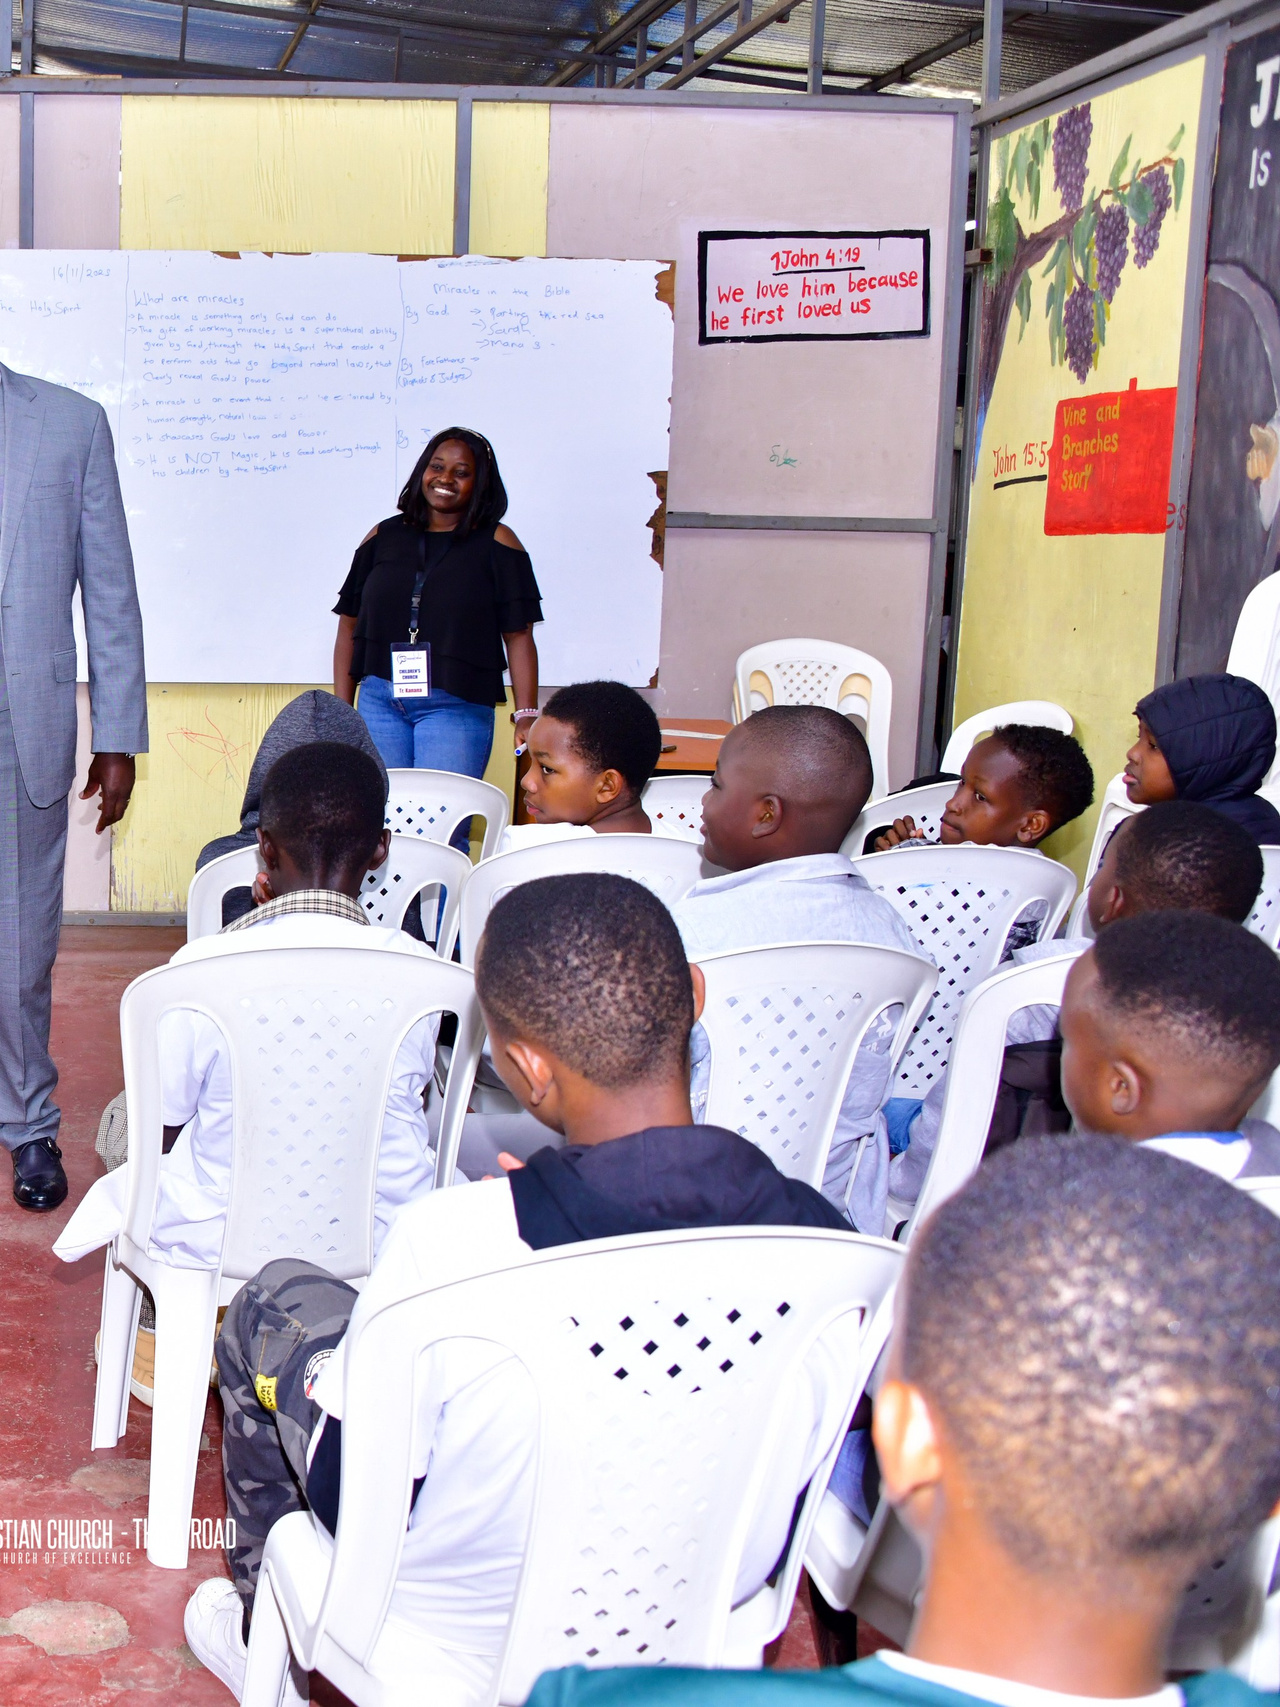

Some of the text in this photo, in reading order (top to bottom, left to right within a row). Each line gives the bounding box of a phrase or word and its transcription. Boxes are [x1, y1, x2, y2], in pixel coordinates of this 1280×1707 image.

[1249, 147, 1273, 189] IS
[771, 246, 861, 272] 1John 4:19
[433, 282, 481, 296] Miracles
[544, 284, 572, 298] Bible
[717, 270, 919, 305] We love him because
[133, 289, 245, 307] What are miracles
[149, 312, 180, 321] miracle
[204, 313, 243, 324] something
[250, 313, 267, 323] only
[275, 312, 295, 321] God
[325, 312, 337, 321] do
[405, 304, 420, 325] By
[584, 312, 605, 321] sea
[711, 298, 871, 332] he first loved us
[158, 326, 177, 340] gift
[184, 325, 194, 333] of
[199, 326, 234, 338] working
[237, 327, 276, 335] miracles
[369, 327, 397, 342] ability
[143, 341, 164, 352] given
[169, 341, 181, 352] by
[324, 341, 344, 350] that
[143, 357, 155, 365] to
[224, 357, 241, 365] that
[246, 360, 259, 371] go
[270, 359, 303, 373] beyond
[309, 359, 339, 368] natural
[375, 359, 393, 368] that
[400, 357, 414, 376] By
[179, 373, 203, 382] reveal
[155, 398, 186, 406] miracle
[380, 391, 391, 405] by
[146, 416, 173, 424] human
[1063, 395, 1121, 428] Vine and
[271, 430, 288, 439] and
[397, 429, 409, 449] By
[168, 455, 177, 464] is
[185, 451, 221, 465] NOT
[282, 450, 291, 458] is
[297, 446, 316, 456] God
[317, 445, 354, 459] working
[1061, 431, 1119, 461] Branches
[992, 444, 1017, 478] John
[175, 466, 210, 476] children
[218, 466, 230, 478] by
